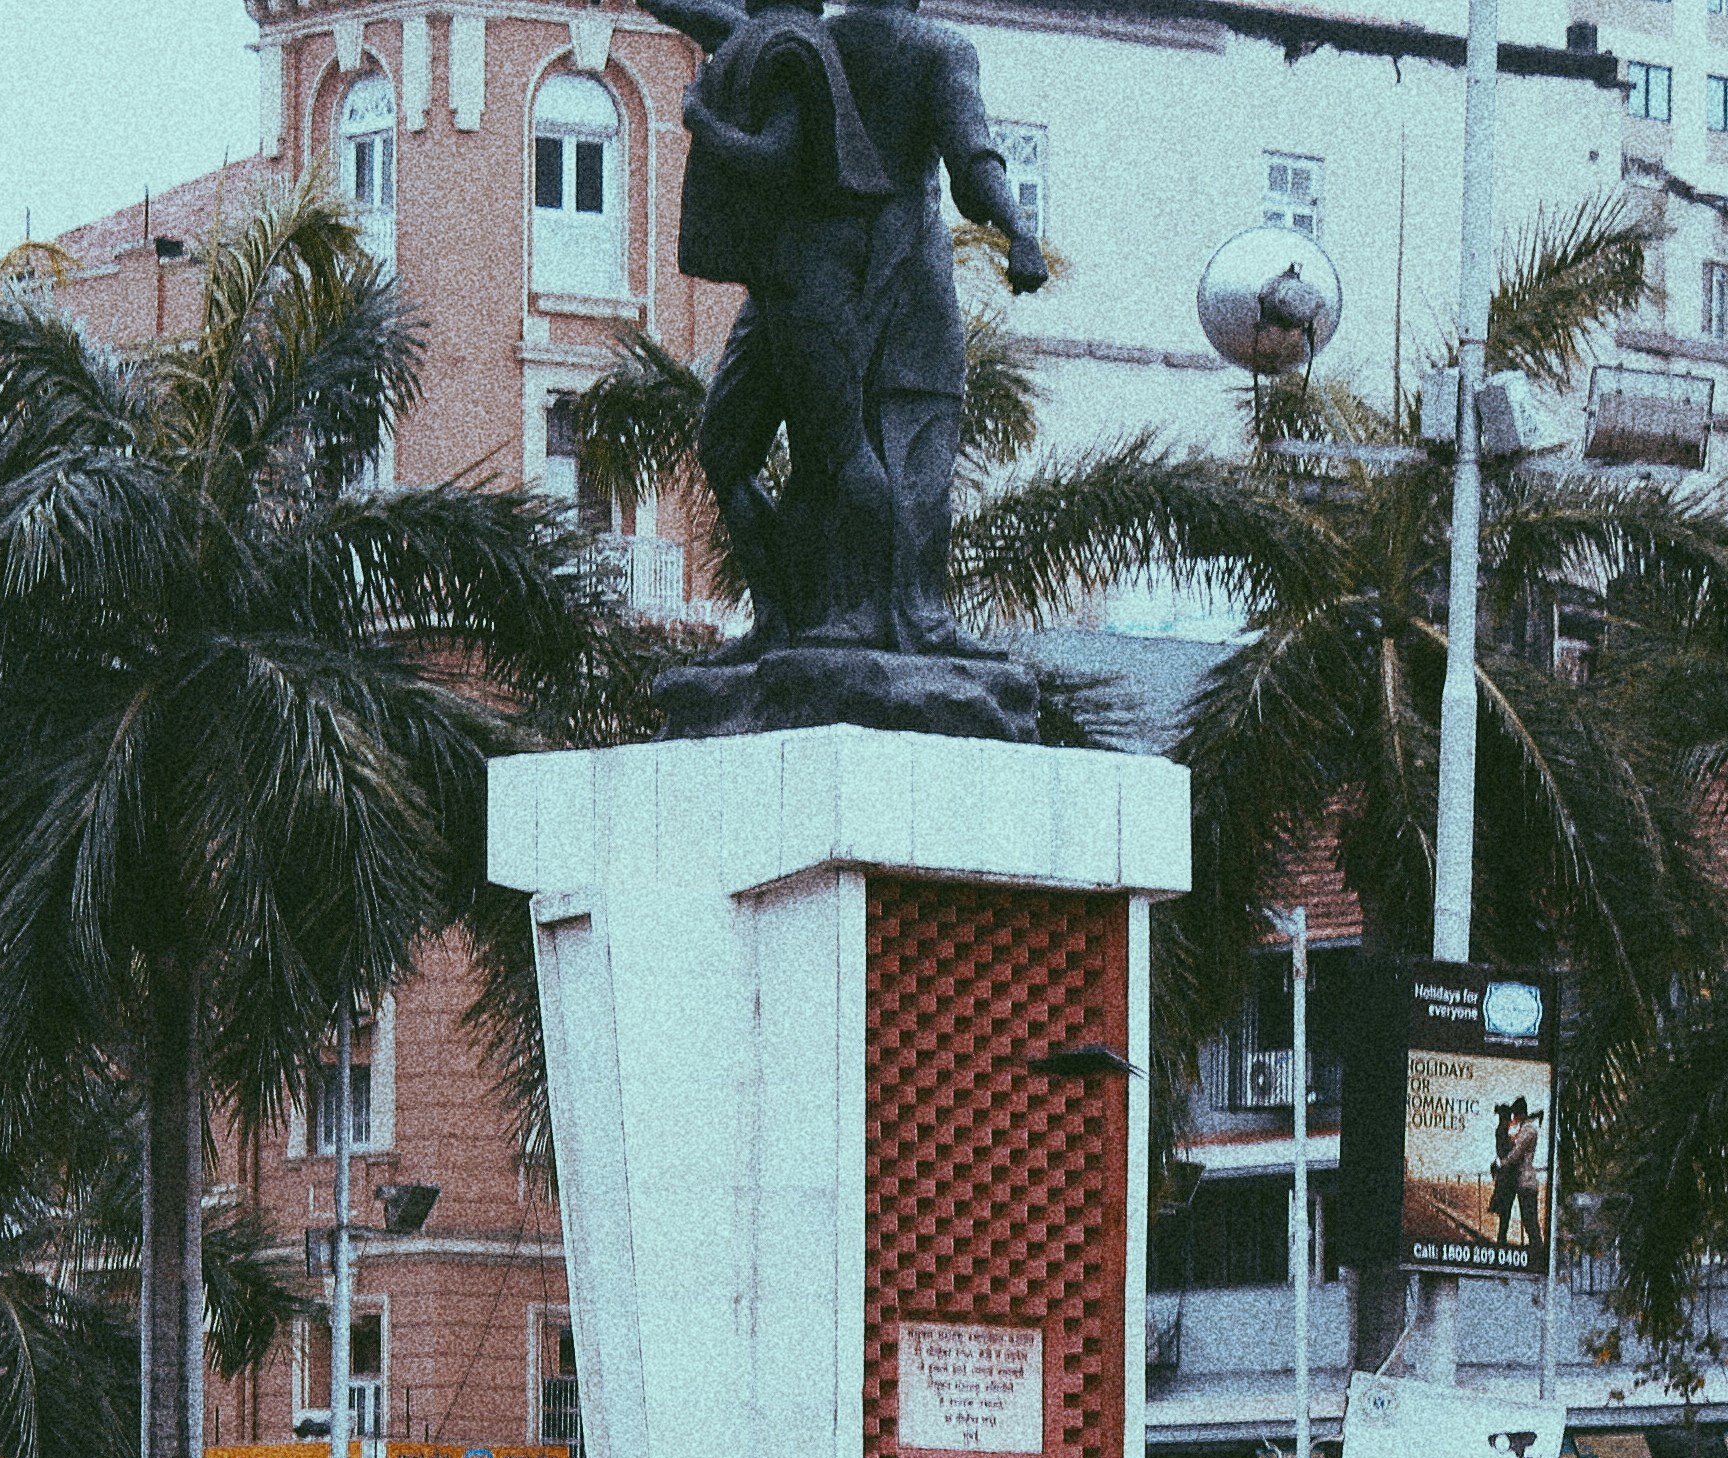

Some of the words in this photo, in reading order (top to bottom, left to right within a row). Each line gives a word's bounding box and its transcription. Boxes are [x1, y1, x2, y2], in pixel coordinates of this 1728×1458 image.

[1414, 982, 1460, 1004] Holidays
[1463, 988, 1478, 1004] for
[1428, 1003, 1478, 1021] everyone
[1498, 1248, 1528, 1267] 0400
